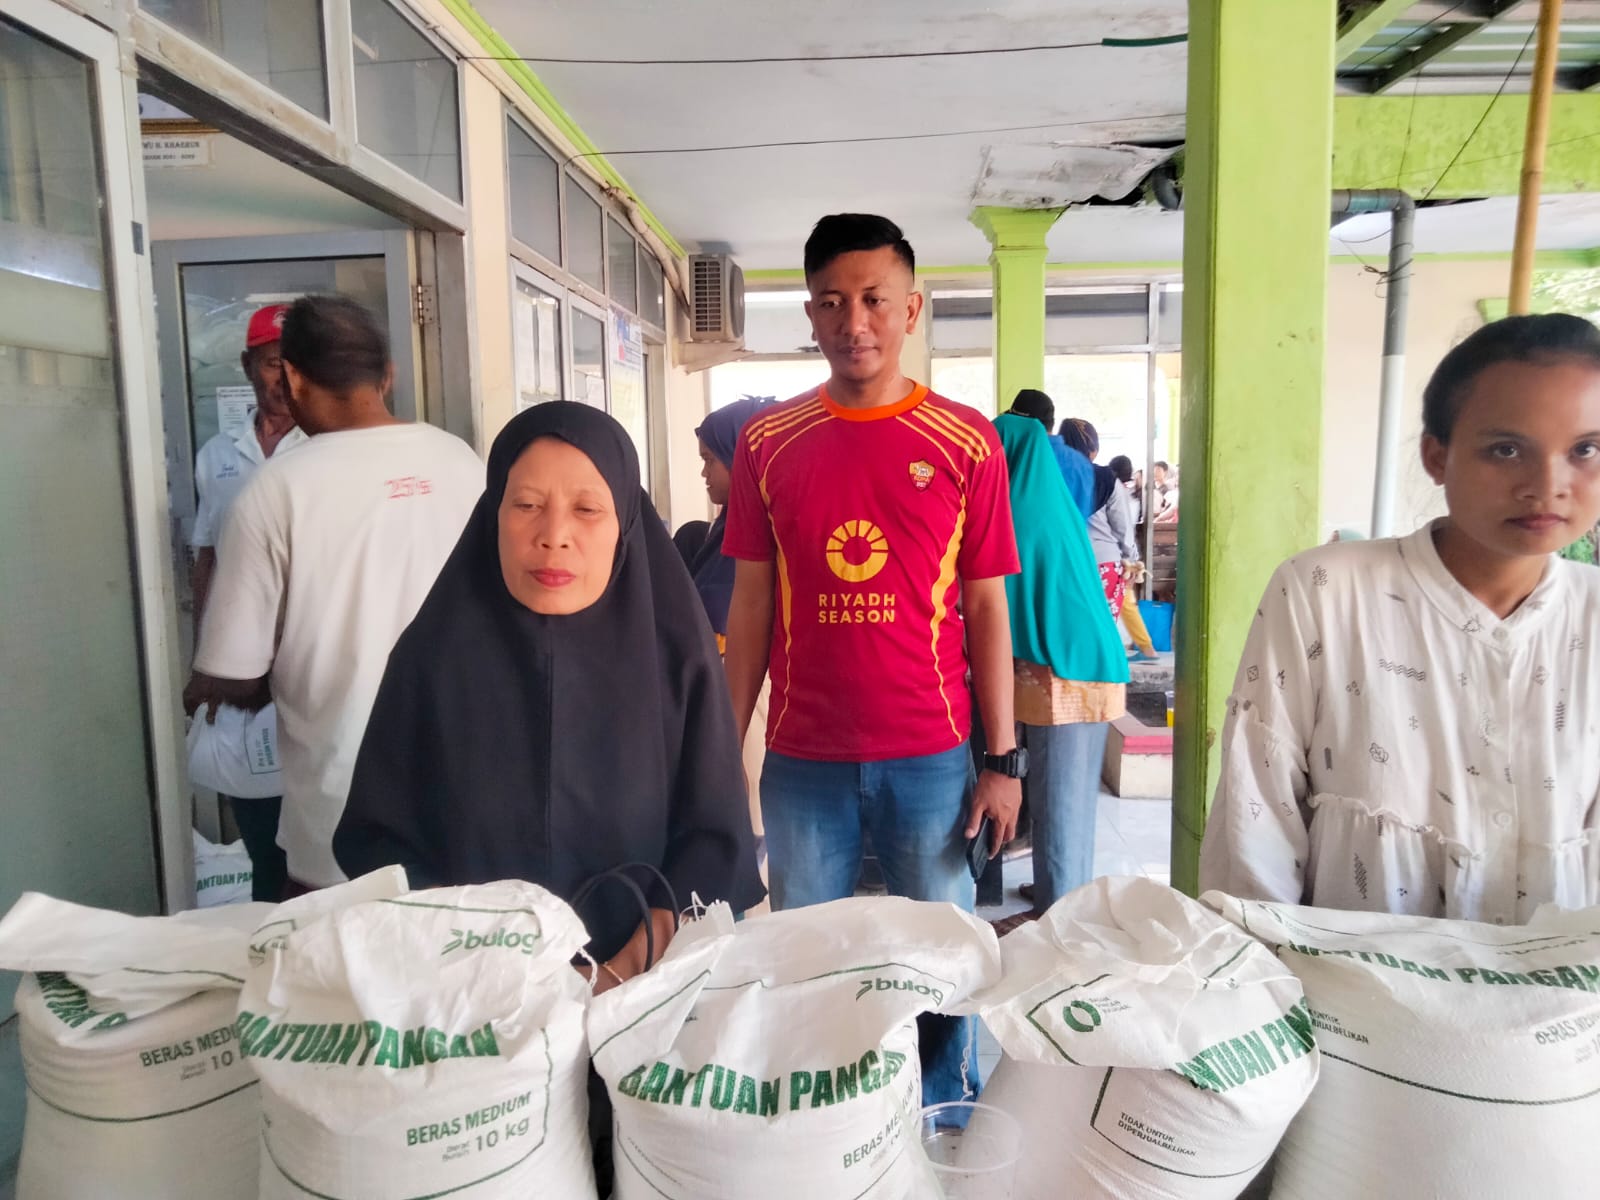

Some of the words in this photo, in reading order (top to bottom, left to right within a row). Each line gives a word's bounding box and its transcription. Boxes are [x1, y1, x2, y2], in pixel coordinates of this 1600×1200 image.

[818, 593, 896, 607] RIYADH
[818, 609, 895, 623] SEASON
[196, 873, 235, 892] ANTUAN
[875, 978, 944, 1007] bulog
[140, 1040, 194, 1068] BERAS
[357, 1020, 500, 1069] PANGAN
[211, 1050, 233, 1071] 10
[406, 1117, 461, 1147] BERAS
[464, 1090, 532, 1131] MEDIUM
[1120, 1111, 1144, 1131] TIDAK
[1145, 1126, 1175, 1143] UNTUK
[475, 1129, 499, 1152] 10
[505, 1117, 530, 1141] kg
[1117, 1119, 1197, 1156] DIPERJUALBELIKAN
[842, 1131, 882, 1169] BERAS
